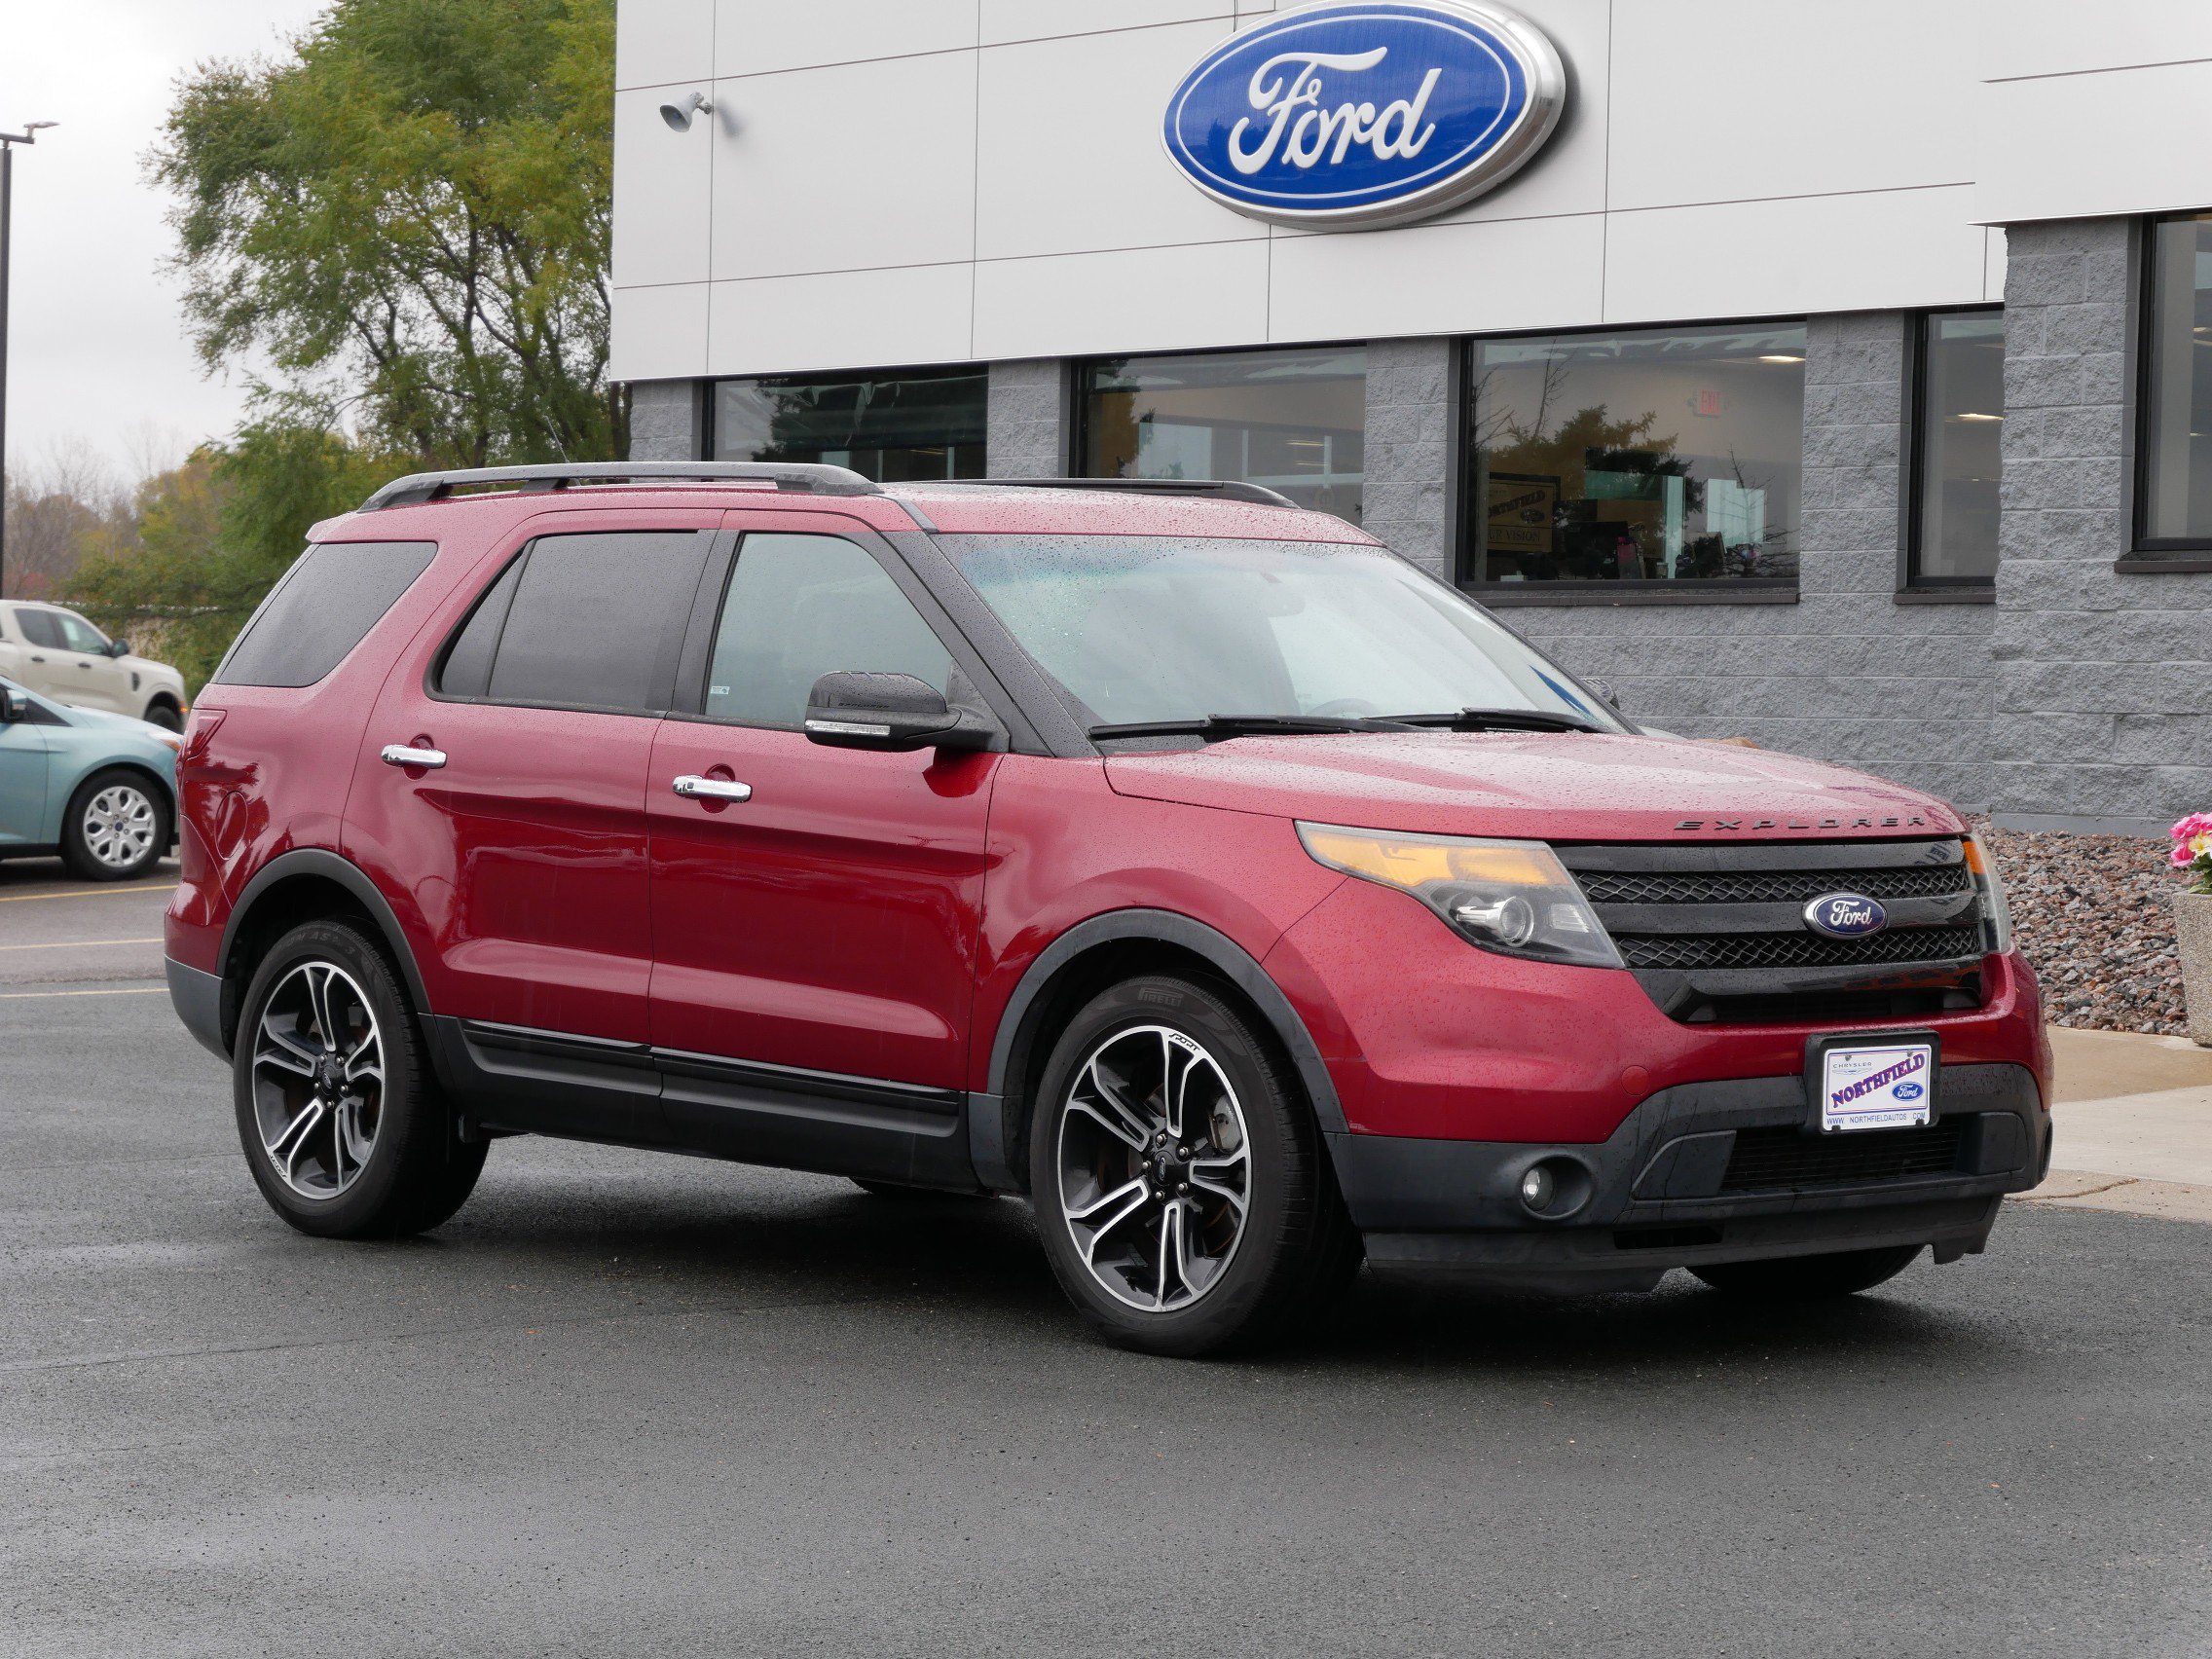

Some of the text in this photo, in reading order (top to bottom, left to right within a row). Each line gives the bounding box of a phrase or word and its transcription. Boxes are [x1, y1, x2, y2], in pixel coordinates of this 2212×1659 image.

[1229, 47, 1443, 174] Ford
[1700, 390, 1721, 413] EXIT
[1674, 816, 1926, 830] EXPLORER
[1829, 900, 1873, 927] Ford
[1137, 986, 1184, 1007] PIRELLI
[1830, 1053, 1926, 1108] NORTHFIELD
[1897, 1084, 1919, 1098] Ford
